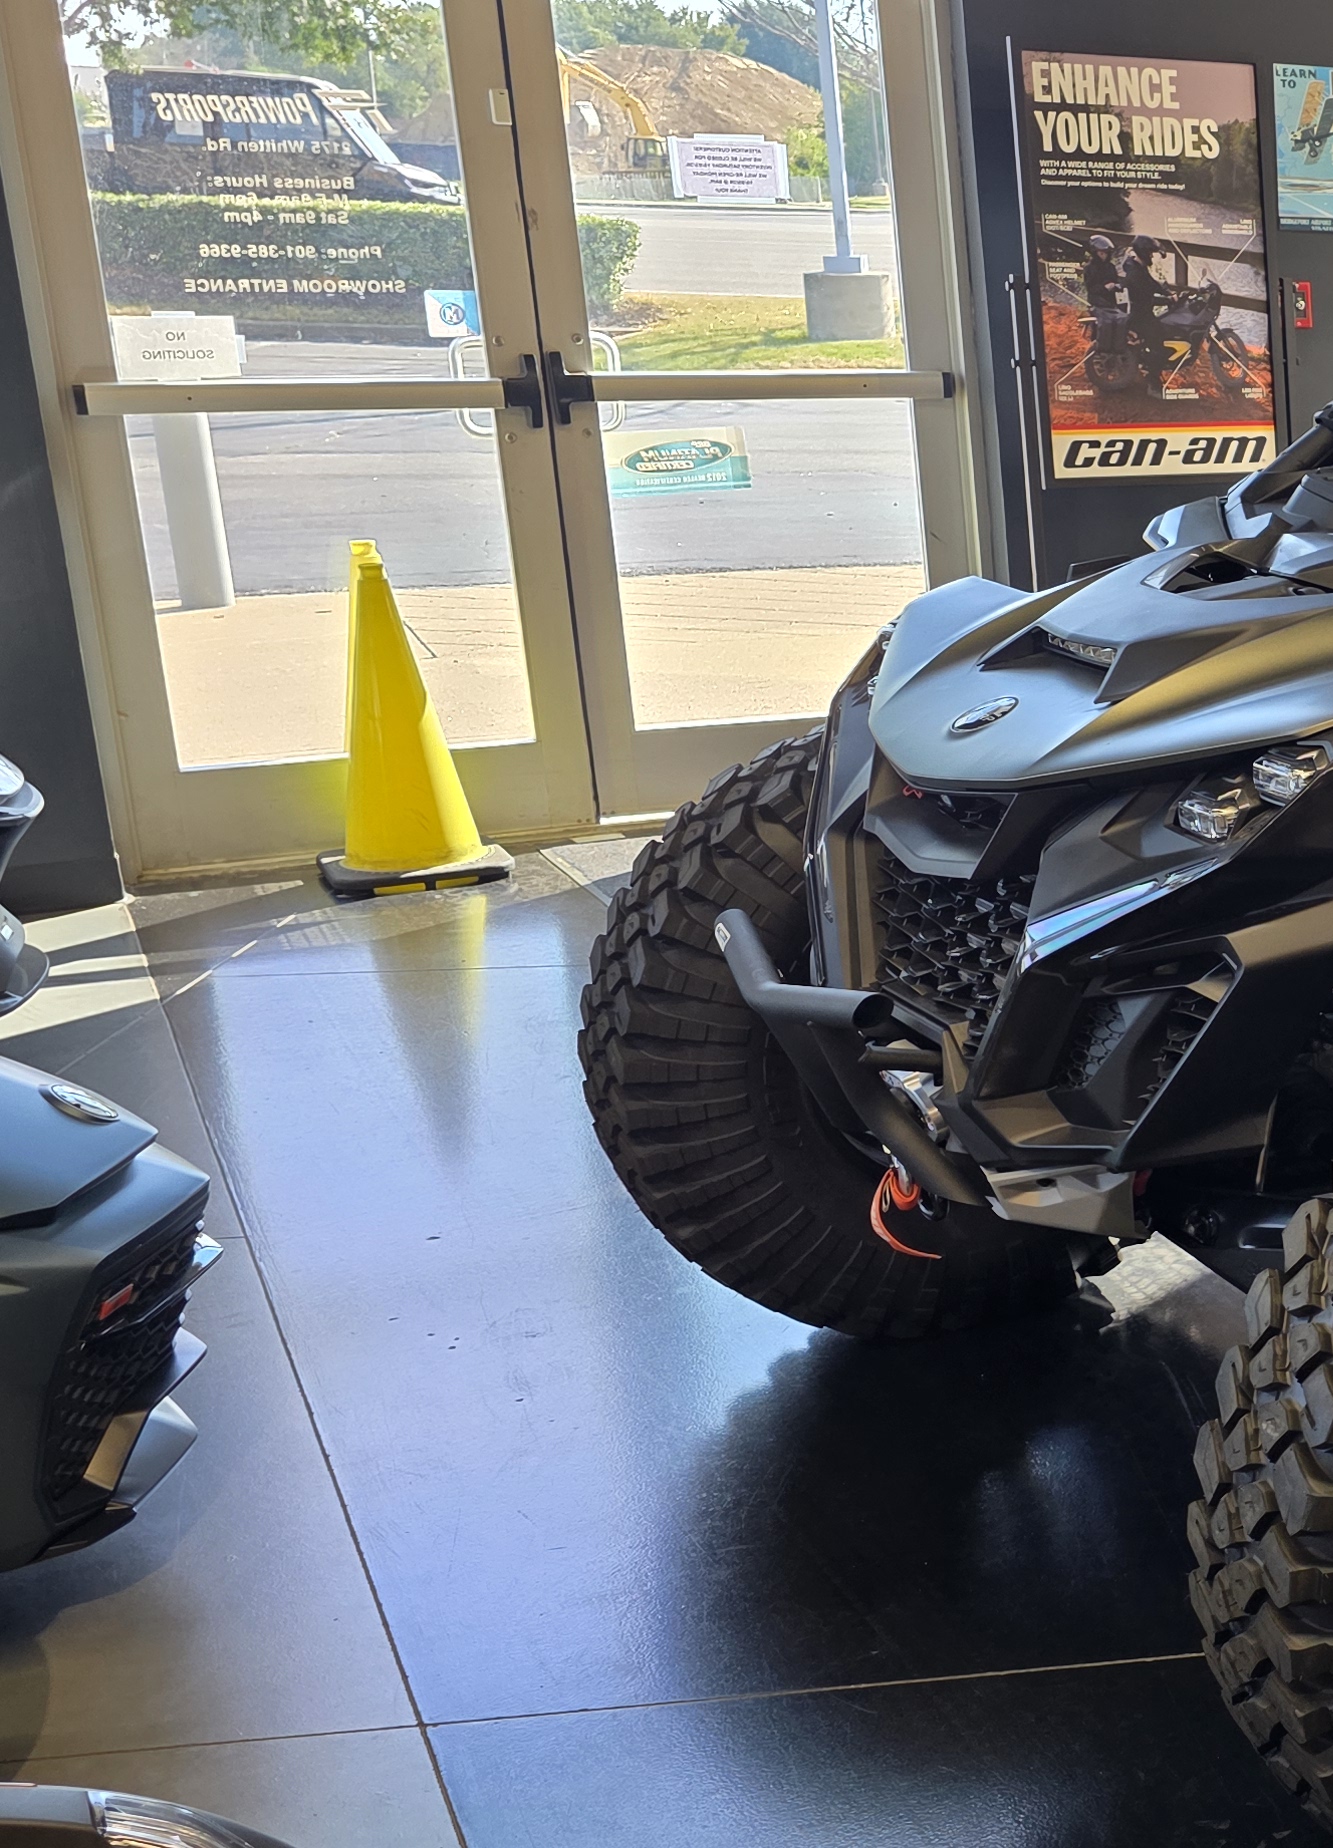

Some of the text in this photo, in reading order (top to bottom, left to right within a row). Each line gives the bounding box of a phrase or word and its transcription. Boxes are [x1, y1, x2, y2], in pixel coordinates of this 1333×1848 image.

[1276, 68, 1316, 78] LEARN
[1032, 61, 1180, 109] ENHANCE
[1281, 79, 1296, 88] TO
[1034, 110, 1220, 159] YOUR RIDES
[1040, 160, 1059, 168] WITH
[1068, 161, 1086, 169] WIDE
[1087, 162, 1114, 170] RANGE
[1116, 162, 1125, 170] OF
[1126, 162, 1175, 172] ACCESSORIES
[1040, 168, 1161, 179] AND APPAREL TO FIT YOUR STYLE.
[1081, 180, 1102, 188] options
[1063, 436, 1267, 468] can-am
